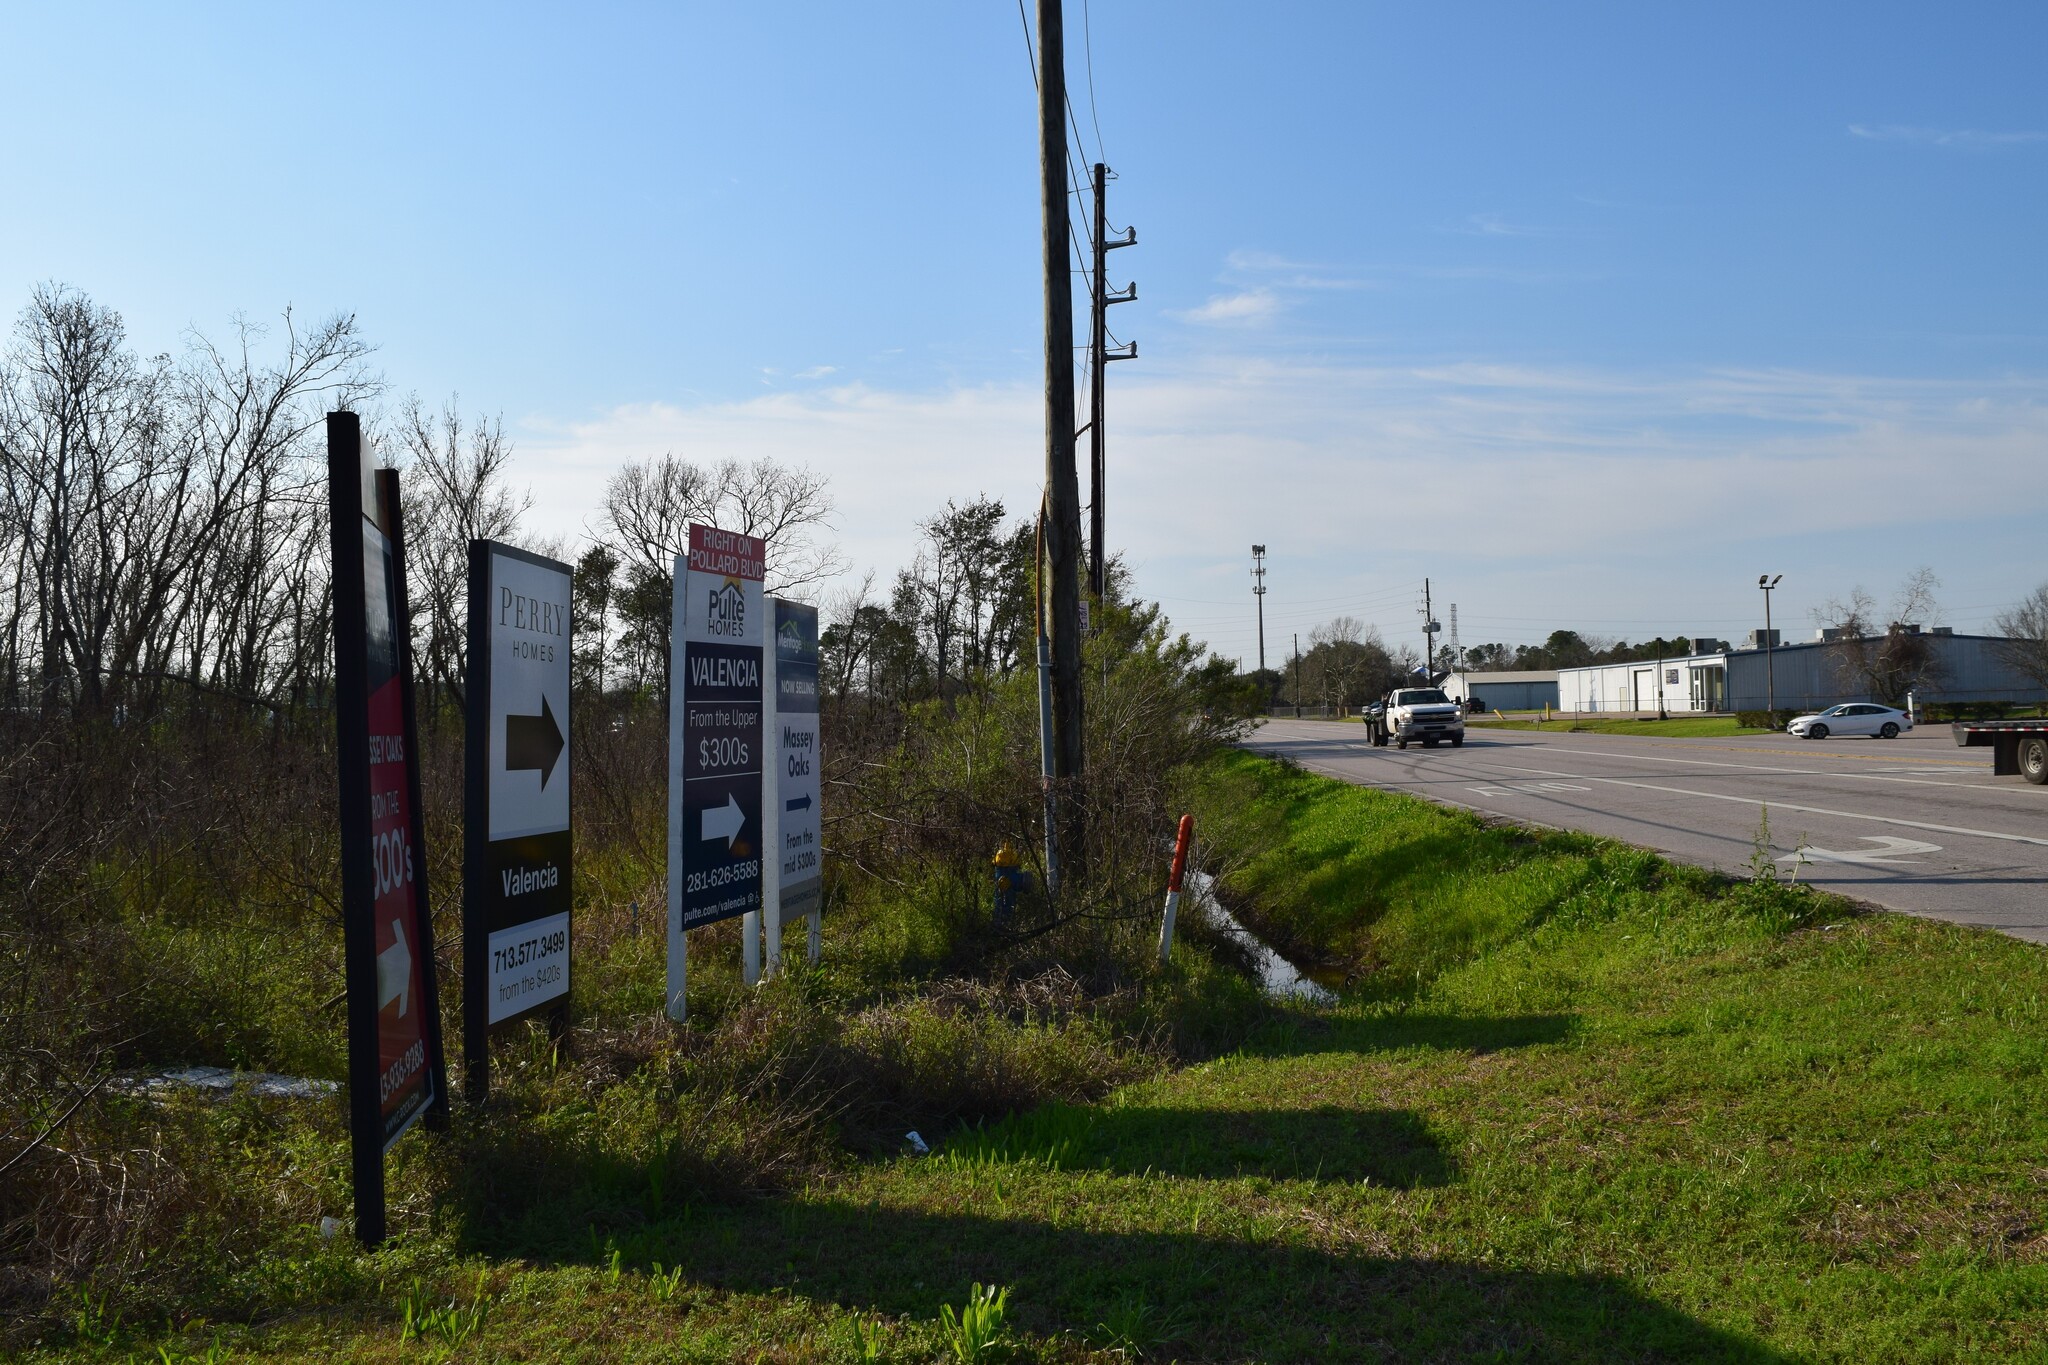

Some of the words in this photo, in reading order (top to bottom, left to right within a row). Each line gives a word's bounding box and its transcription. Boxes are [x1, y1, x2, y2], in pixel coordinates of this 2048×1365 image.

[703, 529, 736, 552] RIGHT
[737, 537, 752, 556] ON
[690, 549, 738, 574] POLLARD
[741, 560, 764, 578] BLVD
[499, 586, 565, 636] PERRY
[708, 590, 745, 621] Pulte
[708, 620, 744, 637] HOMES
[513, 640, 554, 663] HOMES
[691, 657, 758, 687] VALENCIA
[781, 680, 795, 694] NOW
[796, 681, 815, 695] SELLING
[690, 710, 713, 727] From
[715, 709, 730, 726] the
[732, 709, 758, 729] Upper
[369, 735, 385, 765] SSEY
[385, 735, 403, 763] OAKS
[699, 737, 749, 770] $300s
[783, 726, 814, 754] Massey
[788, 754, 810, 778] Oaks
[372, 794, 387, 821] ROM
[386, 790, 400, 816] THE
[786, 833, 801, 850] From
[803, 827, 813, 844] the
[372, 826, 413, 901] 300's
[687, 860, 758, 893] 281-626-5588
[784, 857, 796, 875] mid
[797, 851, 816, 870] $300s
[502, 861, 558, 897] Valencia
[684, 895, 746, 924] pulte.com/valencia
[494, 930, 565, 974] 713.577.3499
[499, 981, 519, 1003] from
[522, 975, 535, 994] the
[536, 964, 561, 990] $420s
[380, 1038, 424, 1104] 13-936-9288
